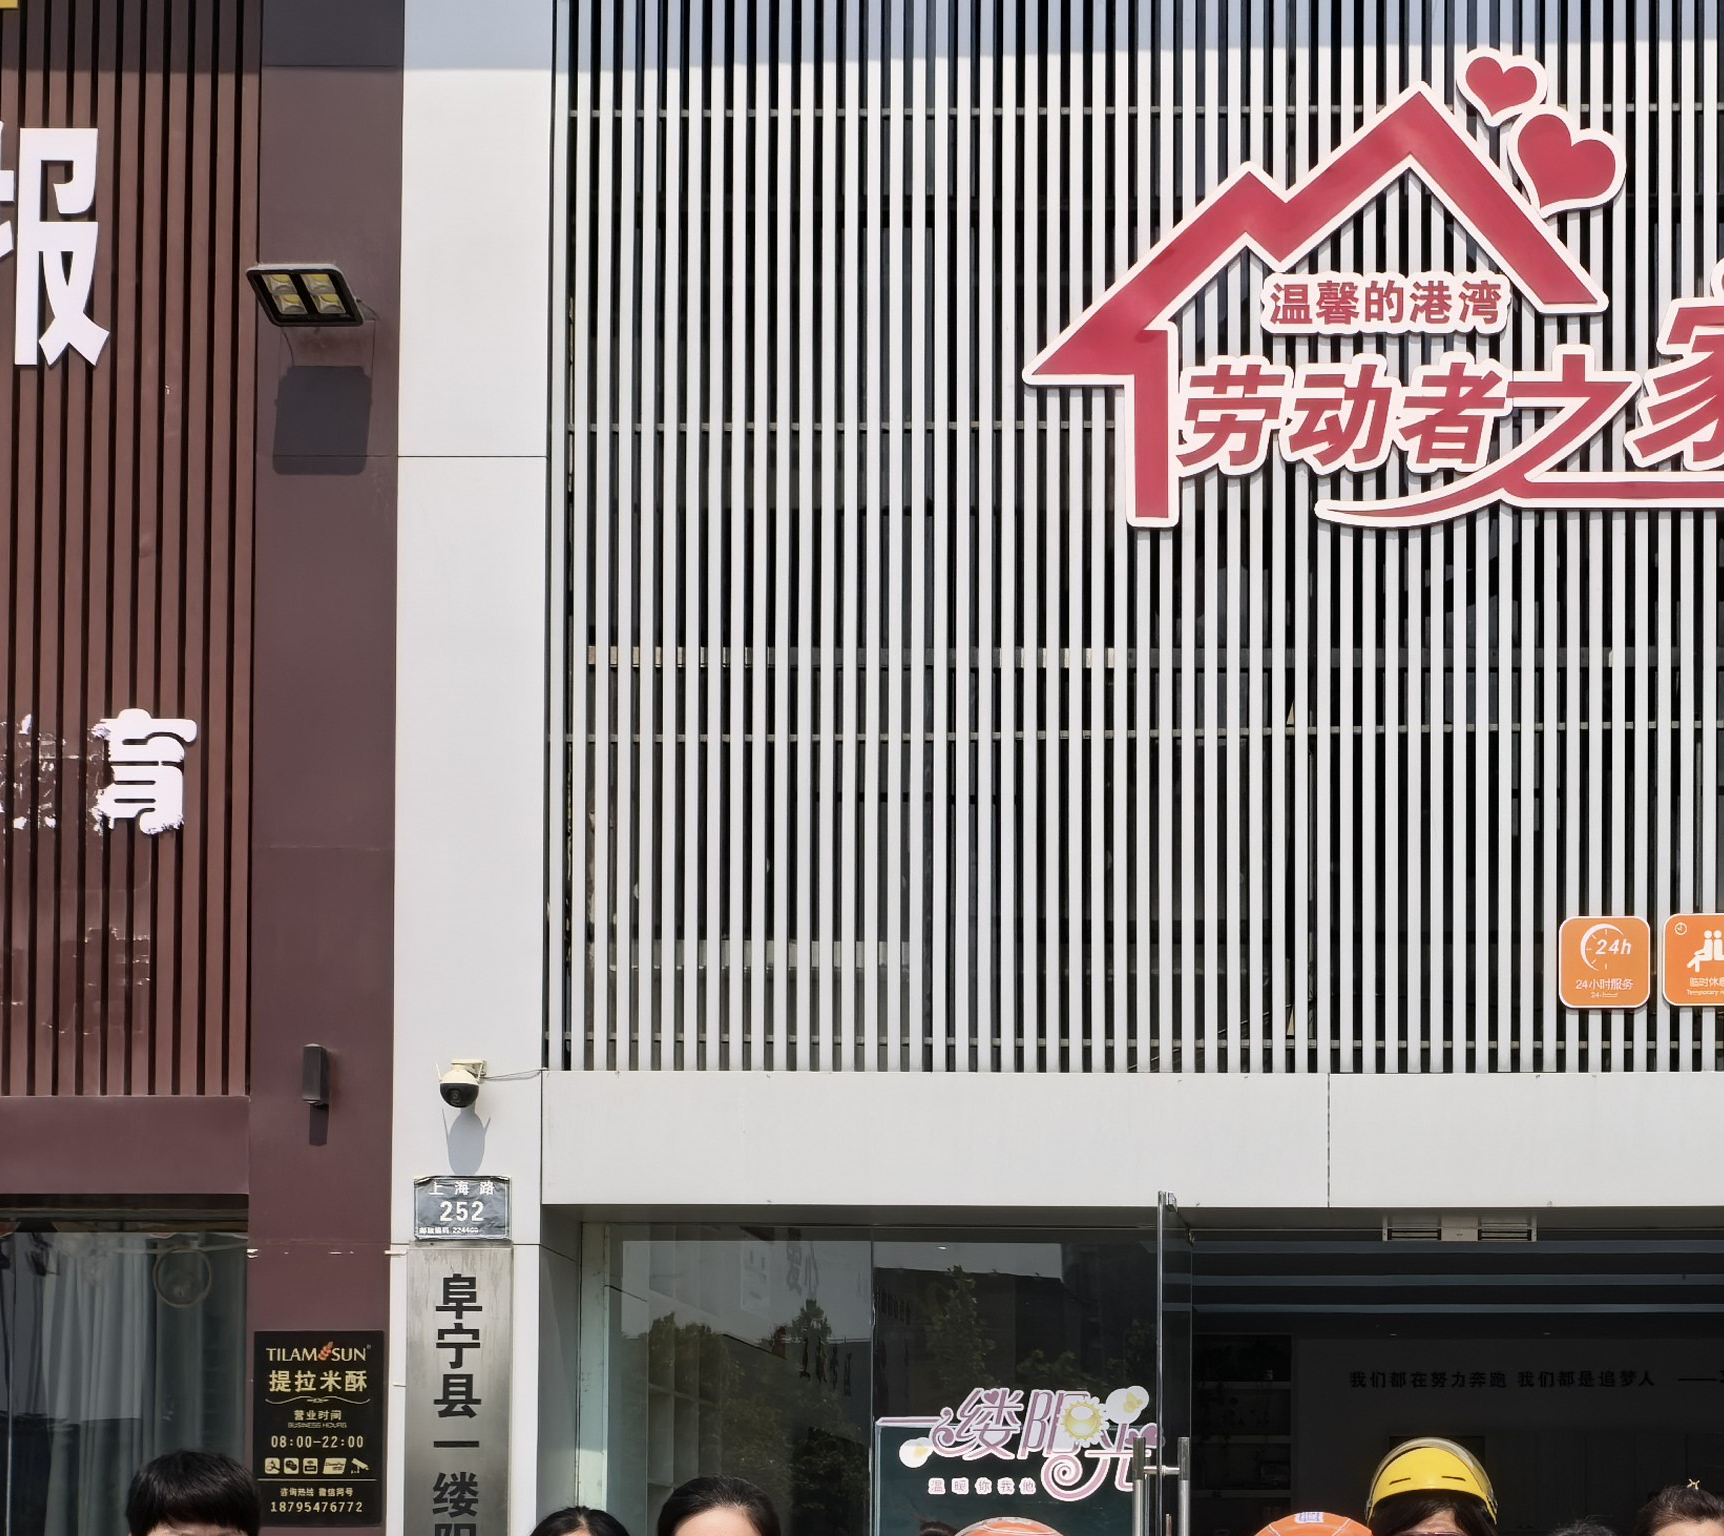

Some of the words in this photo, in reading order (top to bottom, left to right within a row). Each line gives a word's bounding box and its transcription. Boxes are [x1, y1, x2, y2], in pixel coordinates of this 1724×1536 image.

[0, 120, 110, 366] 报
[1271, 281, 1503, 326] 温馨的港湾
[91, 709, 197, 835] 育
[1595, 939, 1632, 955] 24h
[1575, 979, 1634, 990] 24小时服务
[428, 1181, 495, 1195] 上海路
[440, 1201, 484, 1222] 252
[269, 1370, 367, 1392] 提拉米酥
[1349, 1370, 1508, 1389] 我们都在努力奔跑
[1517, 1370, 1655, 1388] 我们都是追梦人
[294, 1410, 342, 1421] 营业时间
[271, 1436, 363, 1448] 08:00-22:00
[928, 1477, 1036, 1494] 温暖你我他
[271, 1502, 363, 1512] 18795476772
